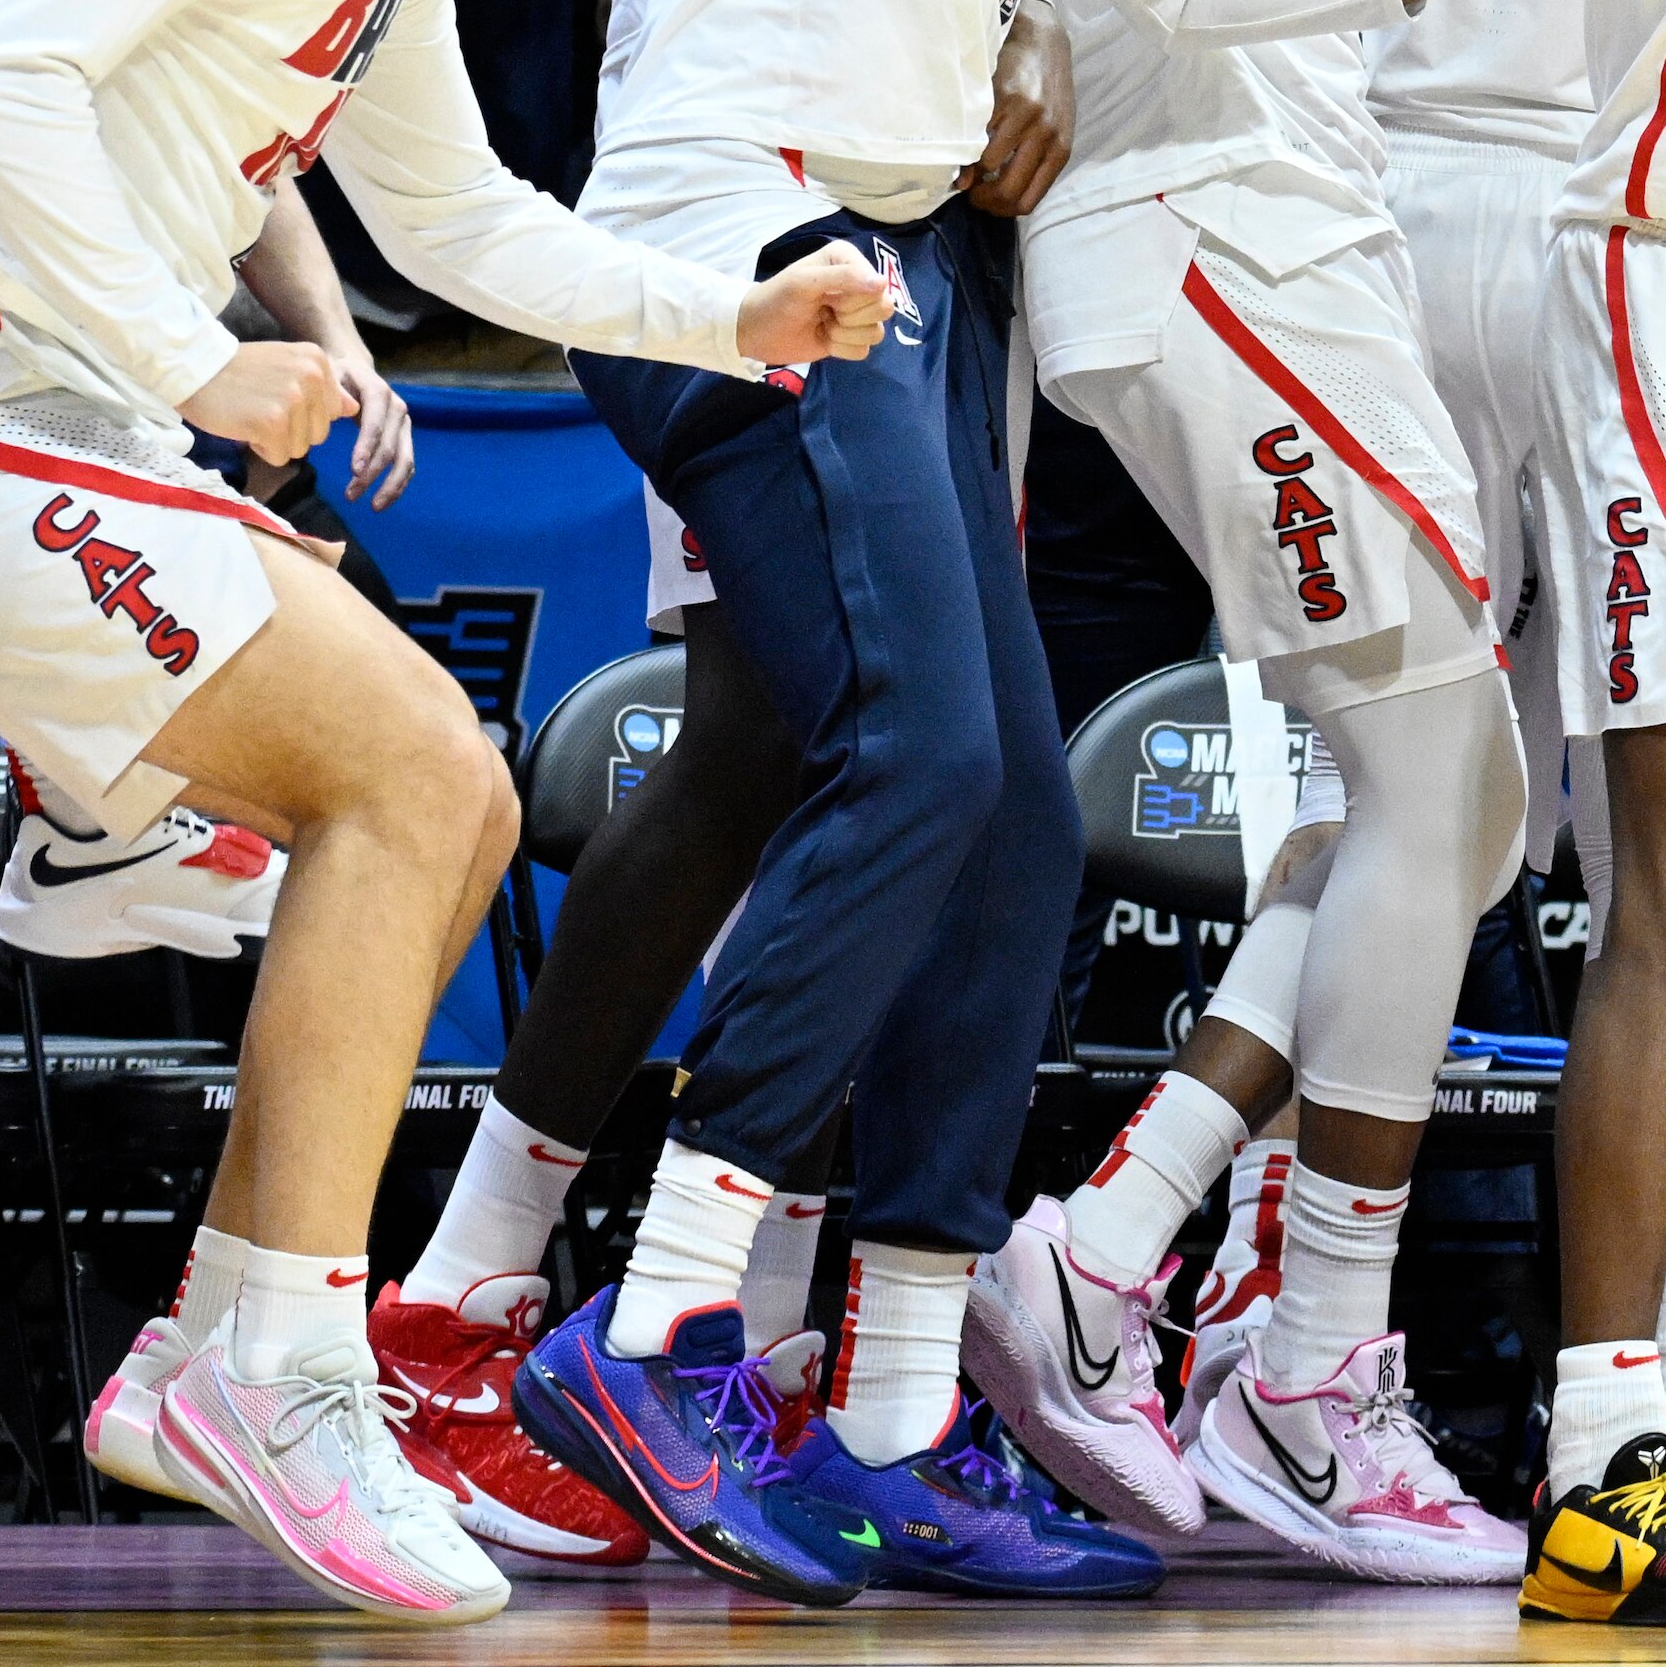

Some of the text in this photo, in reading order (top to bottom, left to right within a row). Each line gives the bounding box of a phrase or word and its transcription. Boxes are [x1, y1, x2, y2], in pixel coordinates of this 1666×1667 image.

[33, 493, 200, 677] CATS
[1252, 424, 1347, 622] CATS
[1606, 497, 1651, 704] CATS
[1481, 1090, 1537, 1115] FOUR
